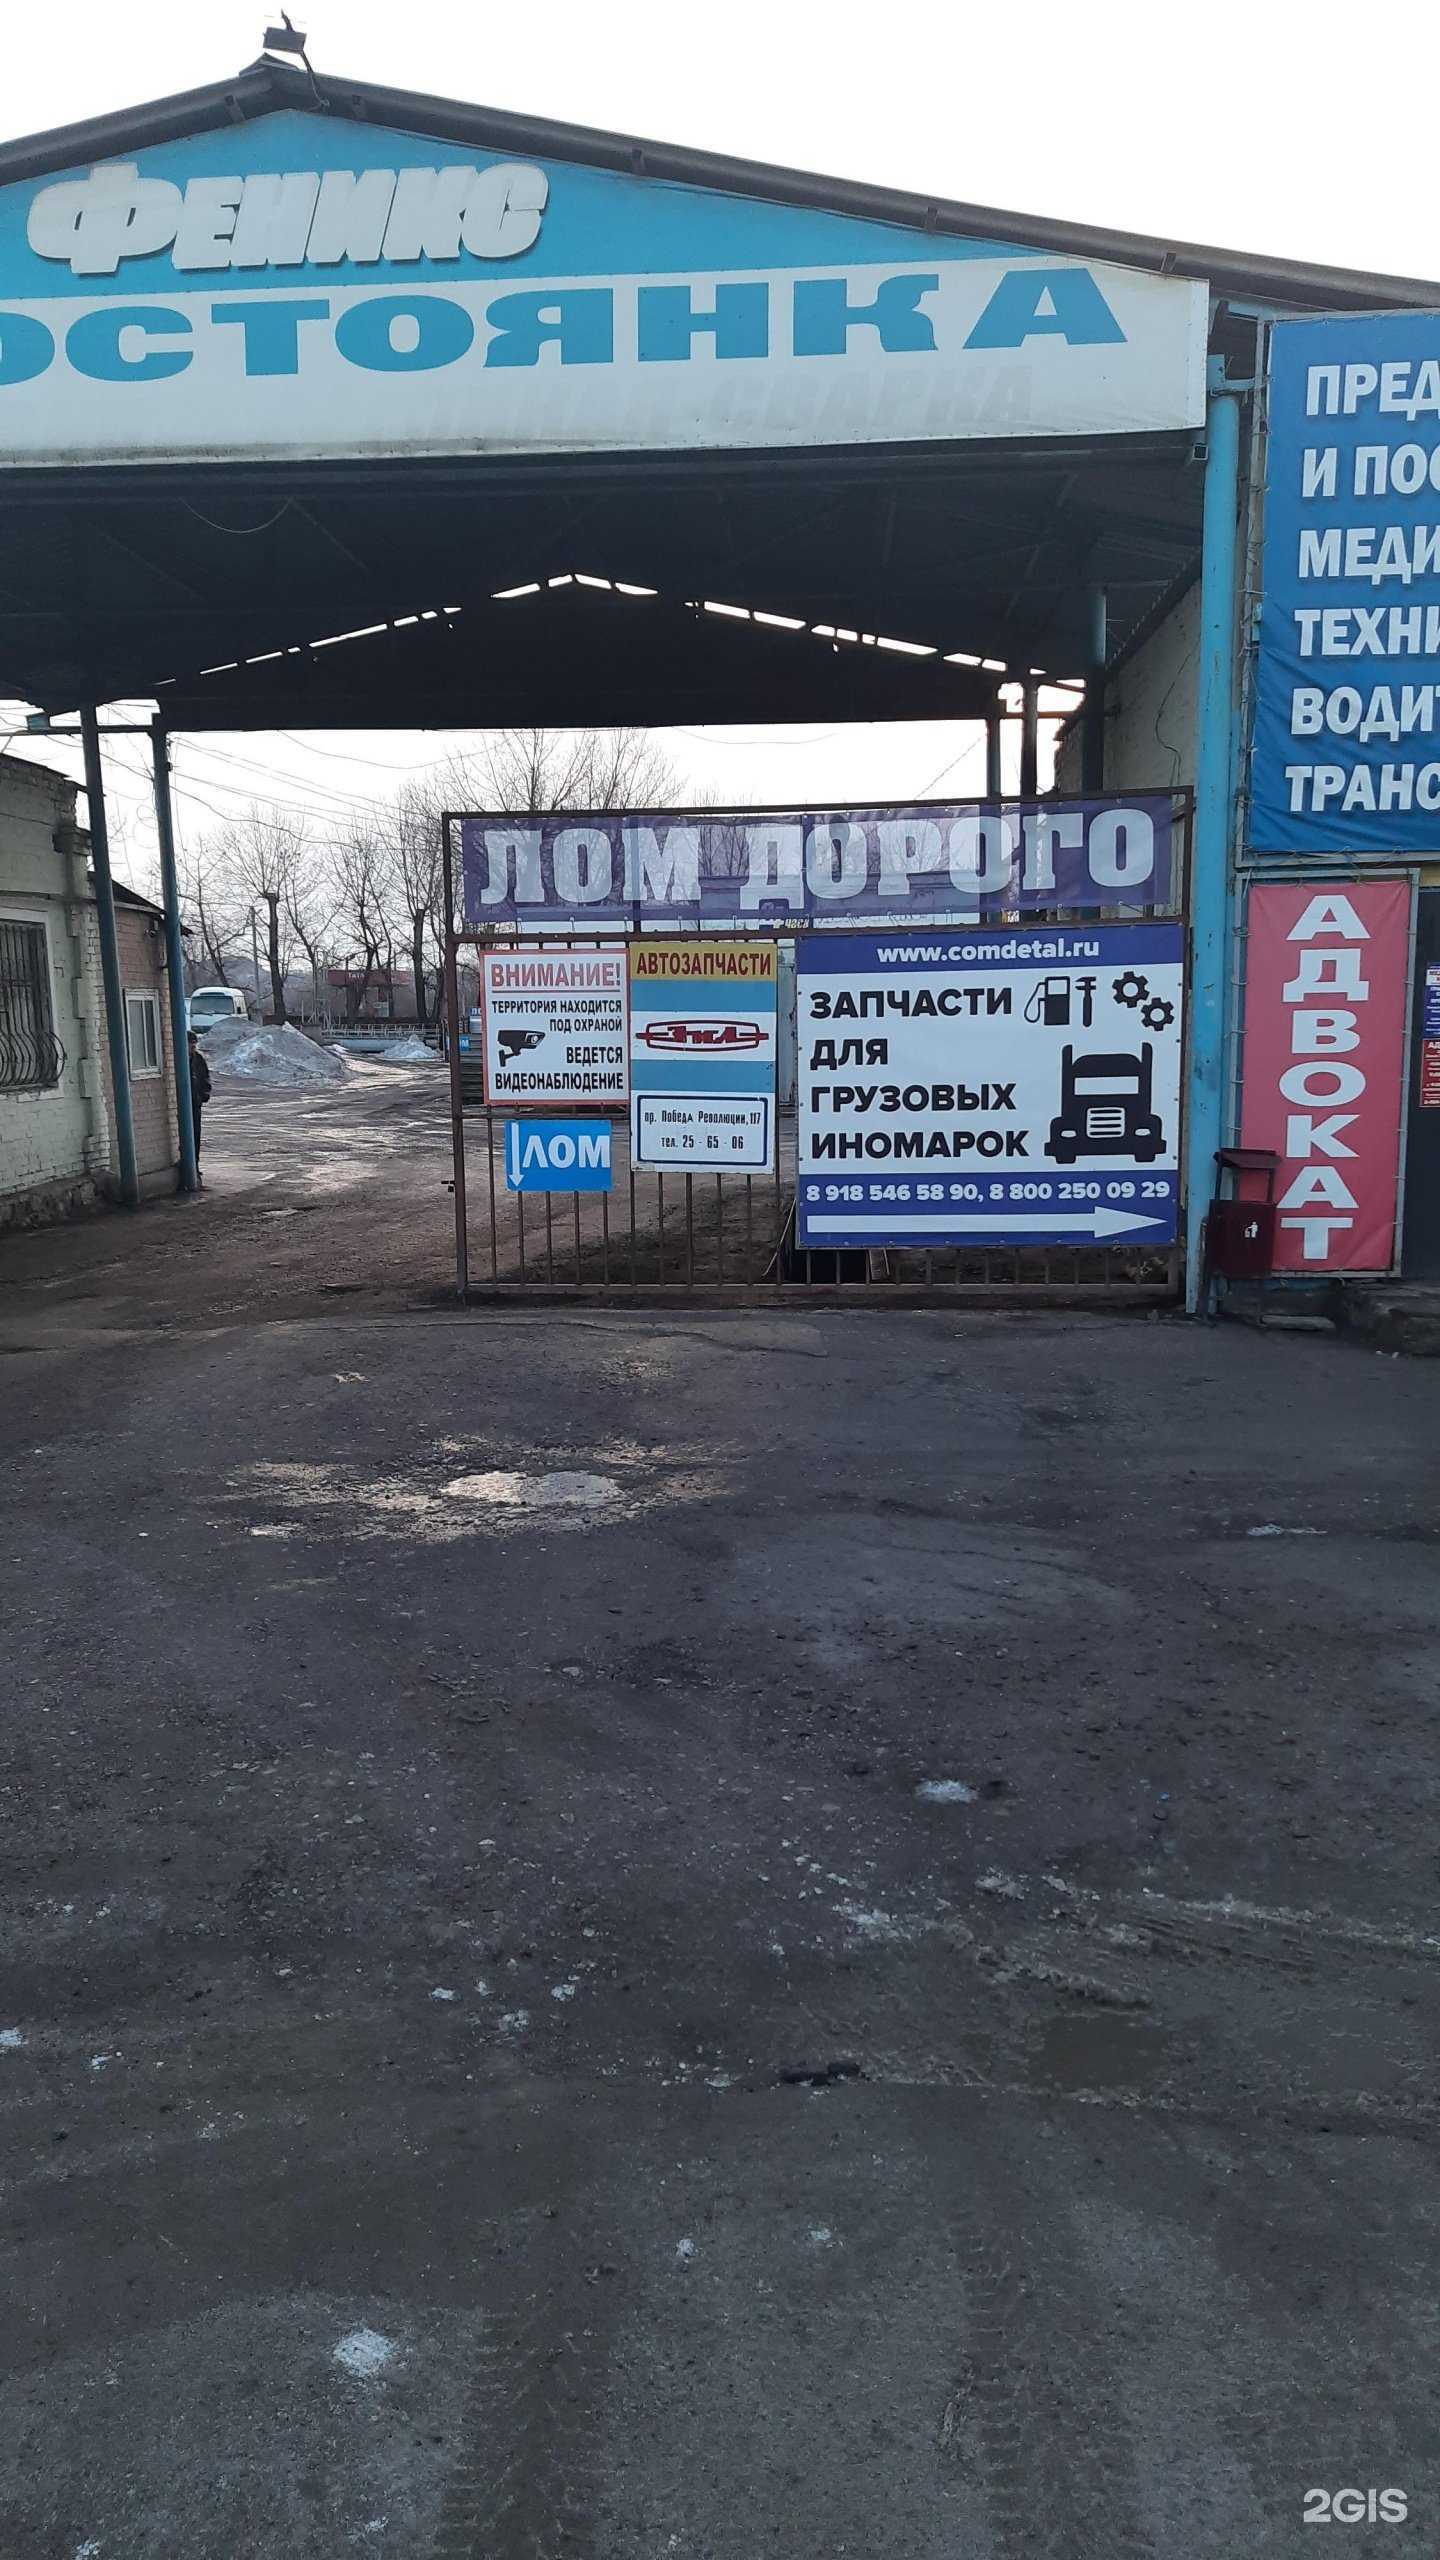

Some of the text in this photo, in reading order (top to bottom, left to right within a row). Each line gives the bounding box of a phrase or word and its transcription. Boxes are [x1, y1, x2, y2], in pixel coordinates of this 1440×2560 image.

[26, 162, 549, 275] ФЕНИКС
[1302, 447, 1338, 498] И
[1299, 525, 1440, 586] МЕДИ
[1291, 685, 1440, 742] ВОДИ
[1285, 762, 1440, 812] ТРАНС
[481, 808, 1155, 910] ЛОМ ДОРОГО
[636, 952, 771, 976] АВТОЗАПЧАСТИ
[877, 938, 1100, 963] www.comdetal.ru
[491, 962, 621, 988] ВНИМАНИЕ!
[492, 1000, 557, 1014] ТЕРРИТОРИЯ
[560, 999, 622, 1016] НАХОДИТСЯ
[809, 987, 1013, 1020] ЗАПЧАСТИ
[549, 1016, 623, 1034] ПОД ОХРАНОЙ
[566, 1046, 623, 1067] ВЕДЕТСЯ
[810, 1038, 889, 1071] ДЛЯ
[495, 1072, 624, 1093] ВИДЕОНАБЛЮДЕНИЕ
[1277, 895, 1371, 1260] АДВОКАТ
[811, 1083, 1017, 1113] ГРУЗОВЫХ
[522, 1135, 610, 1168] ЛОМ
[661, 1136, 679, 1148] тел.
[811, 1130, 1030, 1159] ИНОМАРОК
[805, 1181, 1170, 1203] 8 918 546 58 90, 8 800 250 09 29
